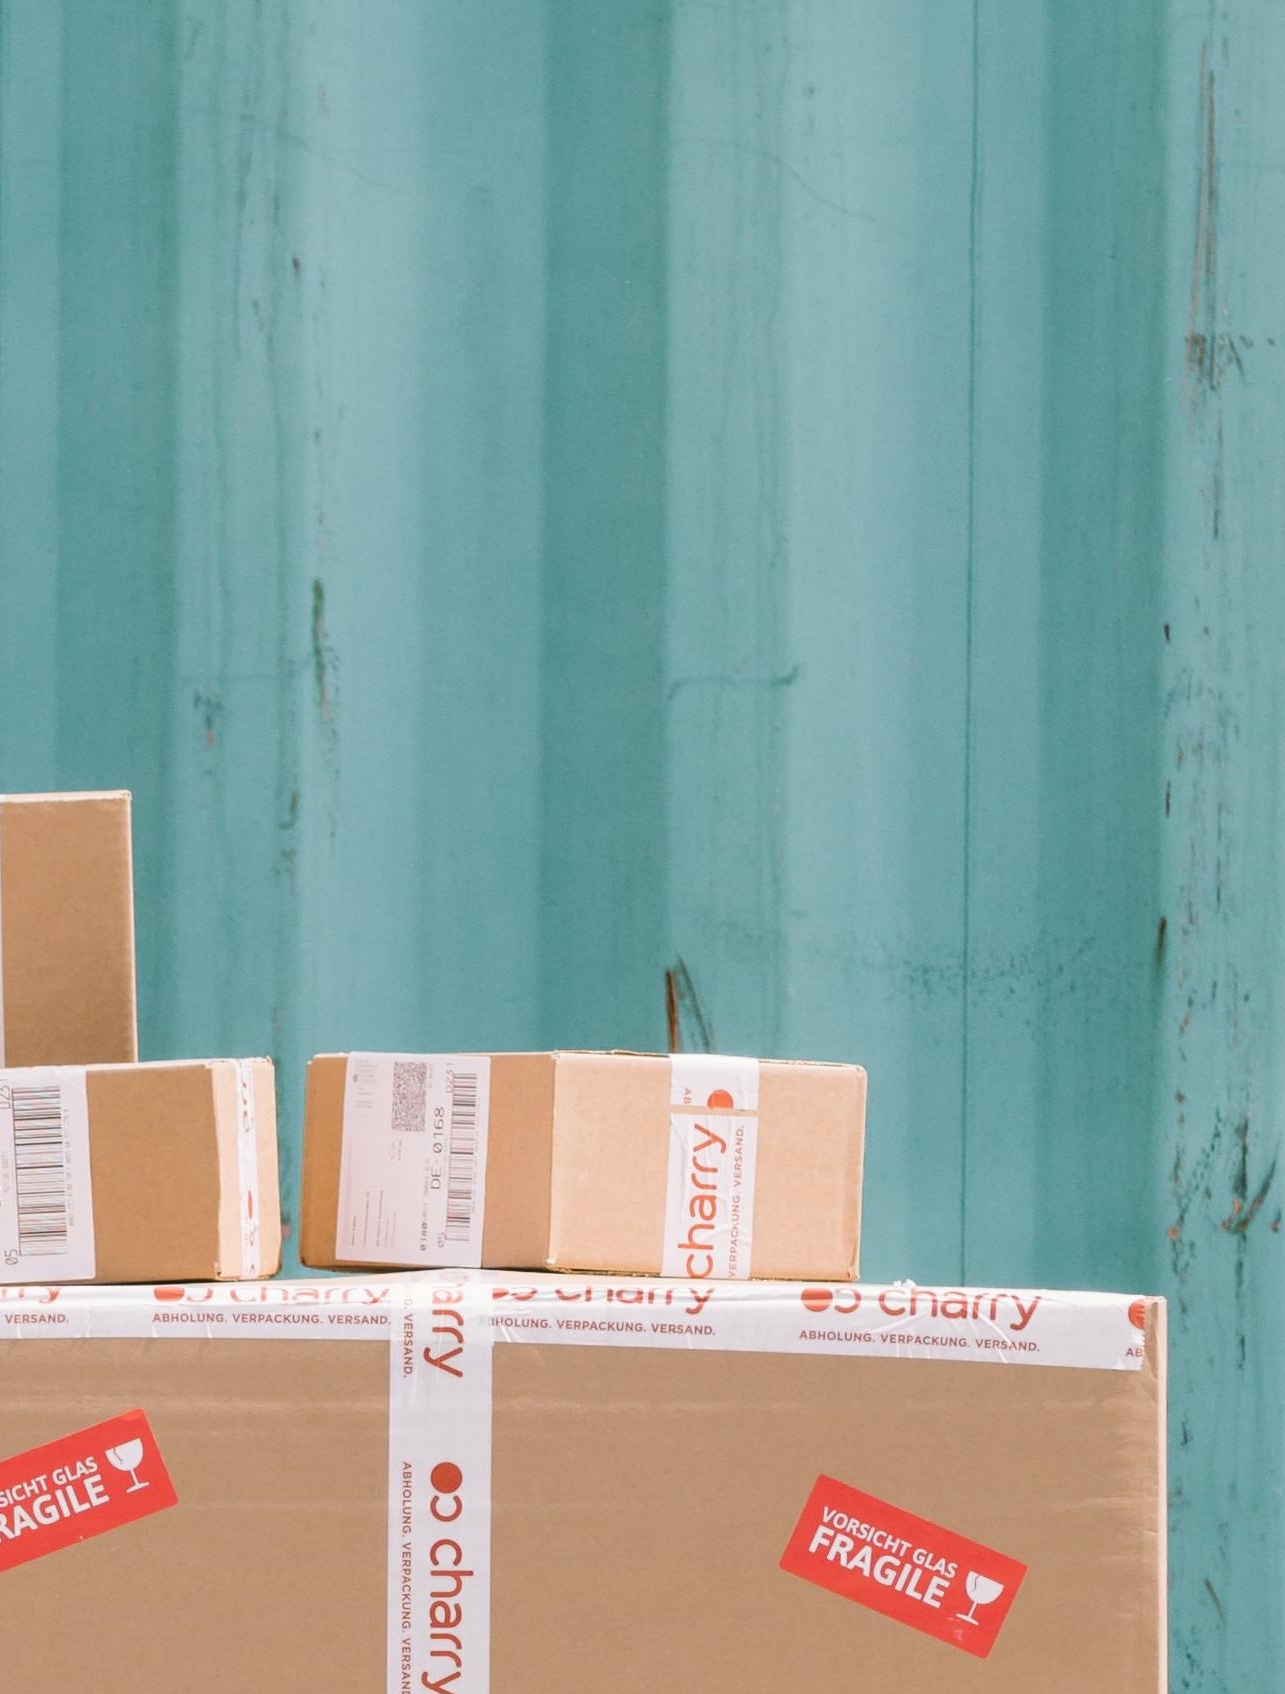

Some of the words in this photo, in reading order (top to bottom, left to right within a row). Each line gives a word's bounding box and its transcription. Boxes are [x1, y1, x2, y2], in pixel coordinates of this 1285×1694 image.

[430, 1107, 445, 1190] DE-0168
[734, 1125, 745, 1189] VERSAND.
[677, 1123, 727, 1279] charry
[728, 1191, 742, 1278] VERPACKUNG.
[5, 1312, 70, 1325] VERSAND.
[152, 1312, 228, 1324] ABHOLUNG.
[232, 1312, 323, 1324] VERPACKUNG.
[327, 1313, 392, 1325] VERSAND.
[556, 1319, 647, 1334] VERPACKUNG.
[650, 1322, 717, 1336] VERSAND.
[798, 1330, 876, 1343] ABHOLUNG.
[880, 1333, 971, 1348] VERPACKUNG.
[975, 1338, 1041, 1352] VERSAND.
[878, 1288, 1042, 1330] charry
[403, 1313, 414, 1379] VERSAND.
[52, 1456, 98, 1485] GLAS
[401, 1461, 413, 1538] ABHOLUNG.
[808, 1525, 950, 1609] FRAGILE
[821, 1506, 912, 1557] VORSICHT
[912, 1549, 958, 1578] GLAS
[401, 1542, 413, 1634] VERPACKUNG.
